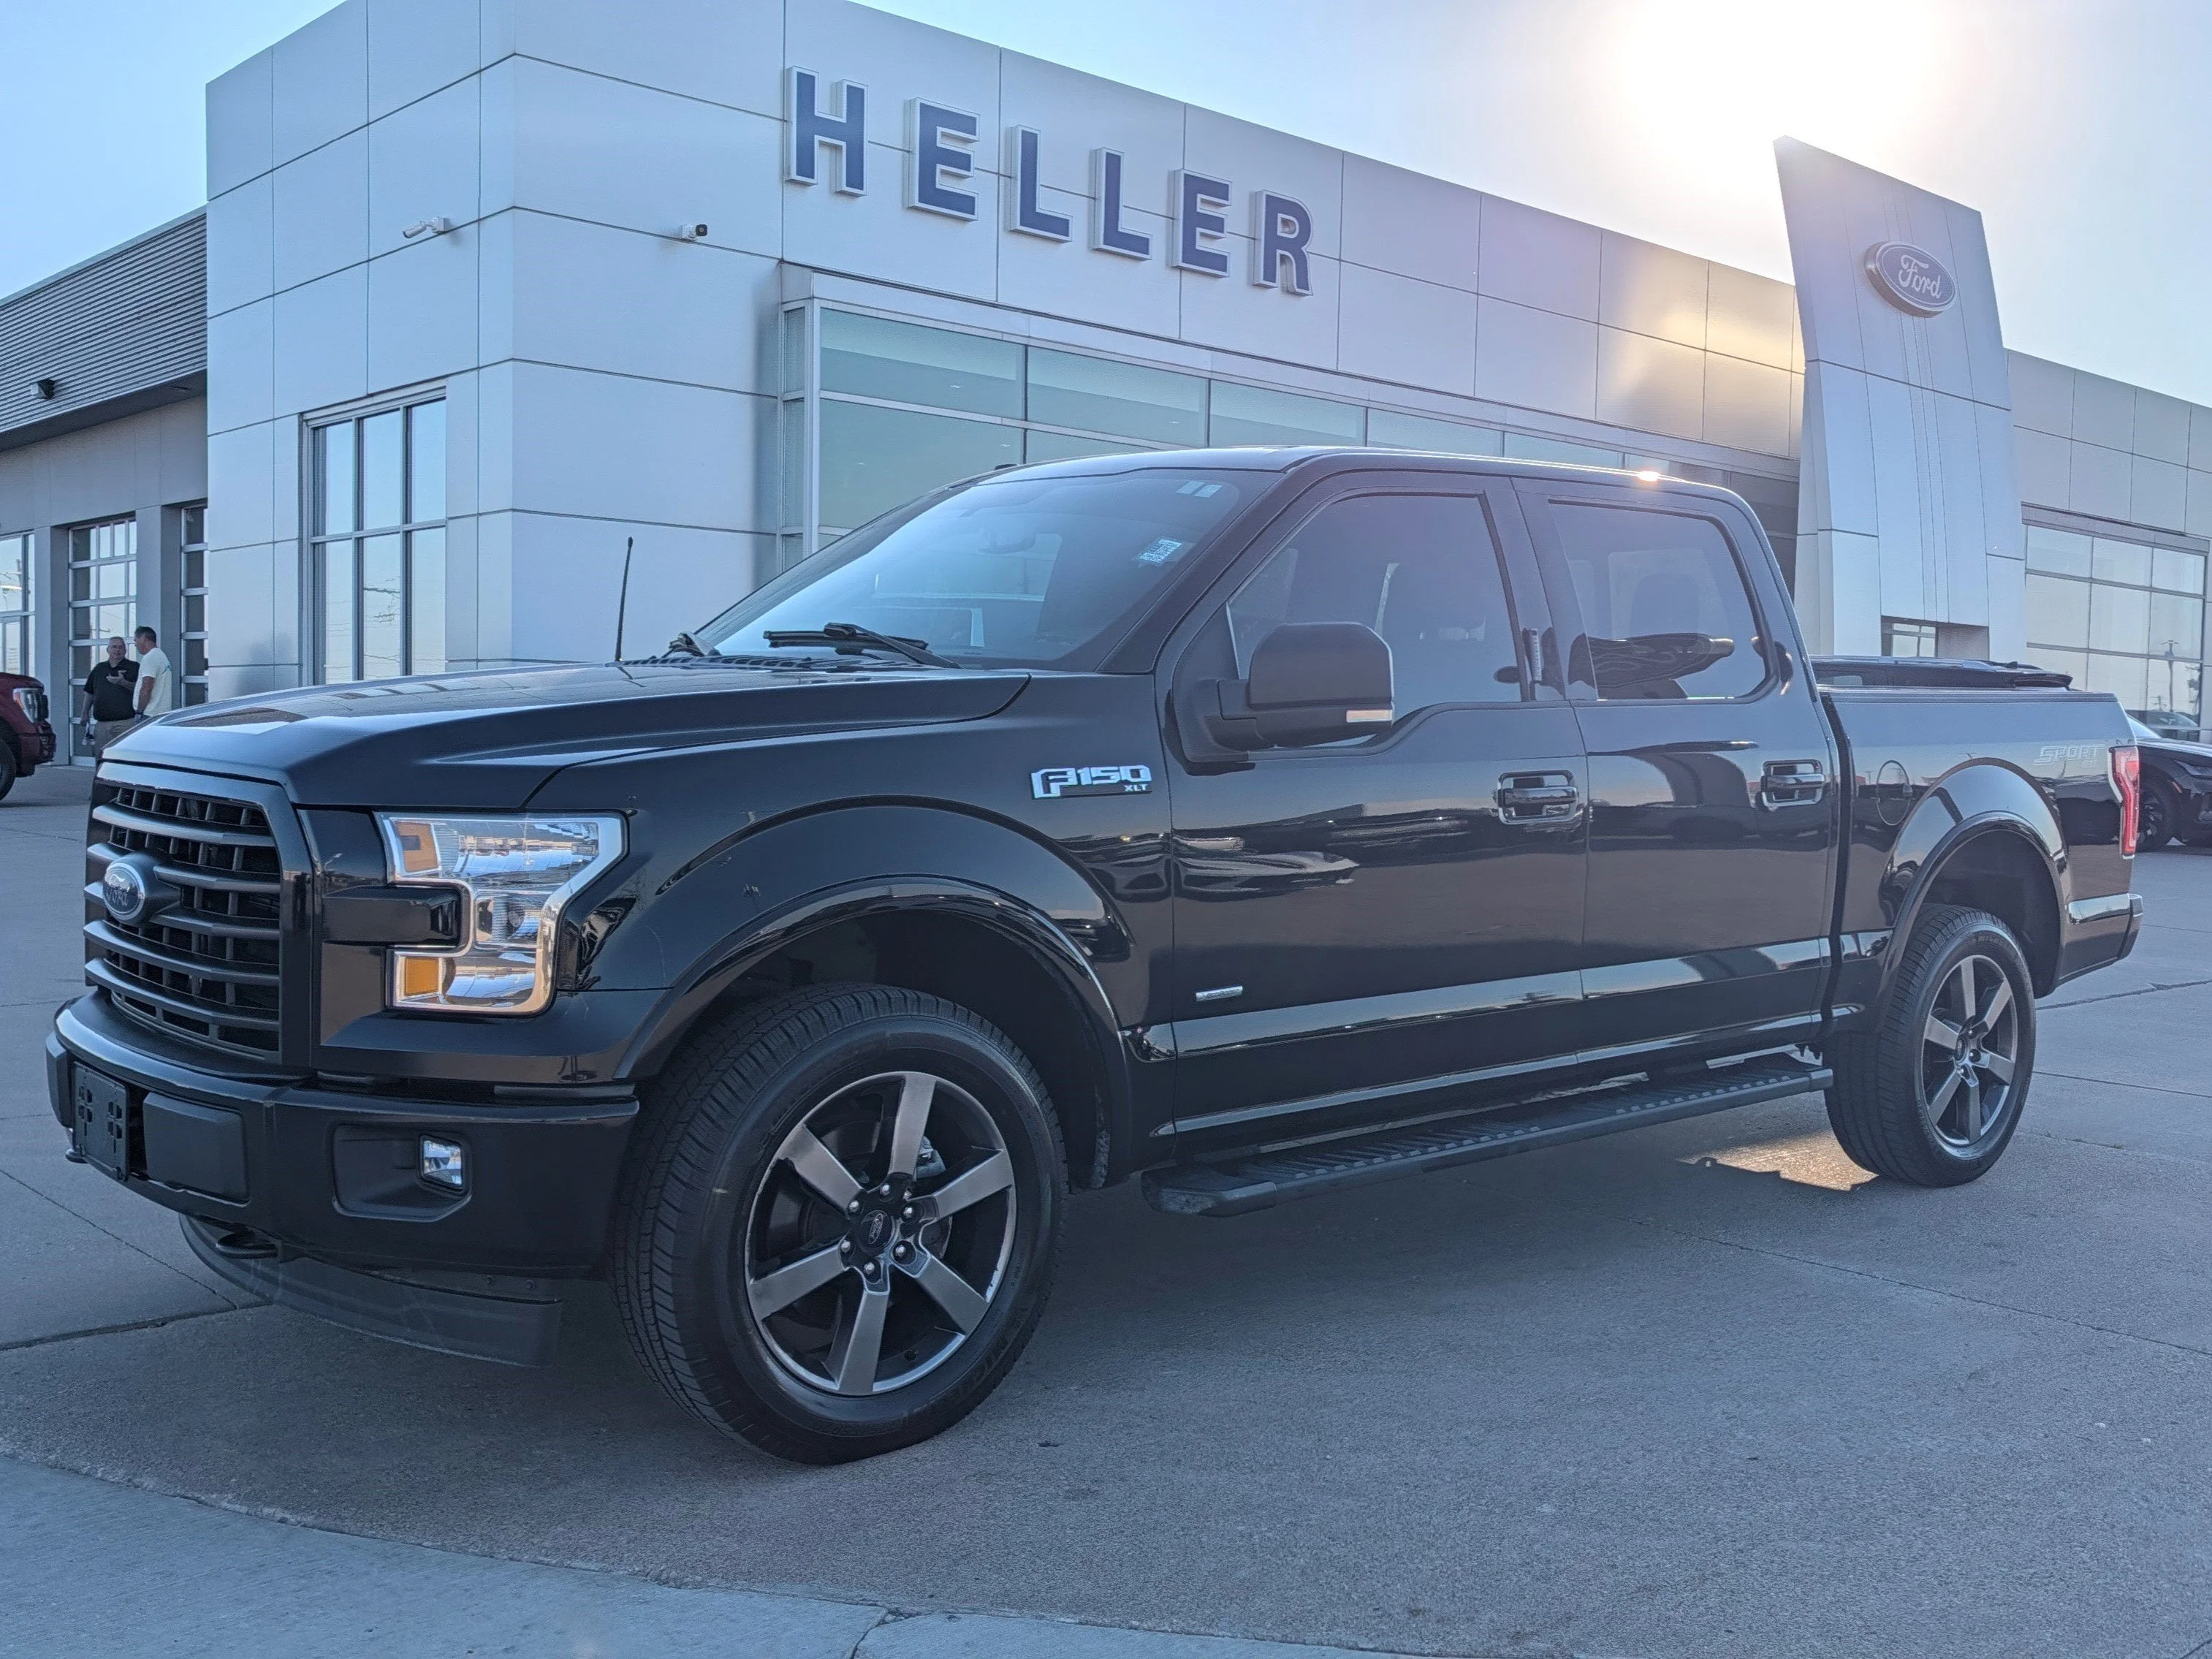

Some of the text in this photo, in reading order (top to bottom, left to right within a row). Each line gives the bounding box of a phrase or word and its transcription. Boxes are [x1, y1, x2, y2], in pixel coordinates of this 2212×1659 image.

[785, 66, 1314, 296] HELLER
[1898, 254, 1942, 299] Ford
[2033, 743, 2105, 766] SPORT
[1124, 783, 1149, 792] XLT
